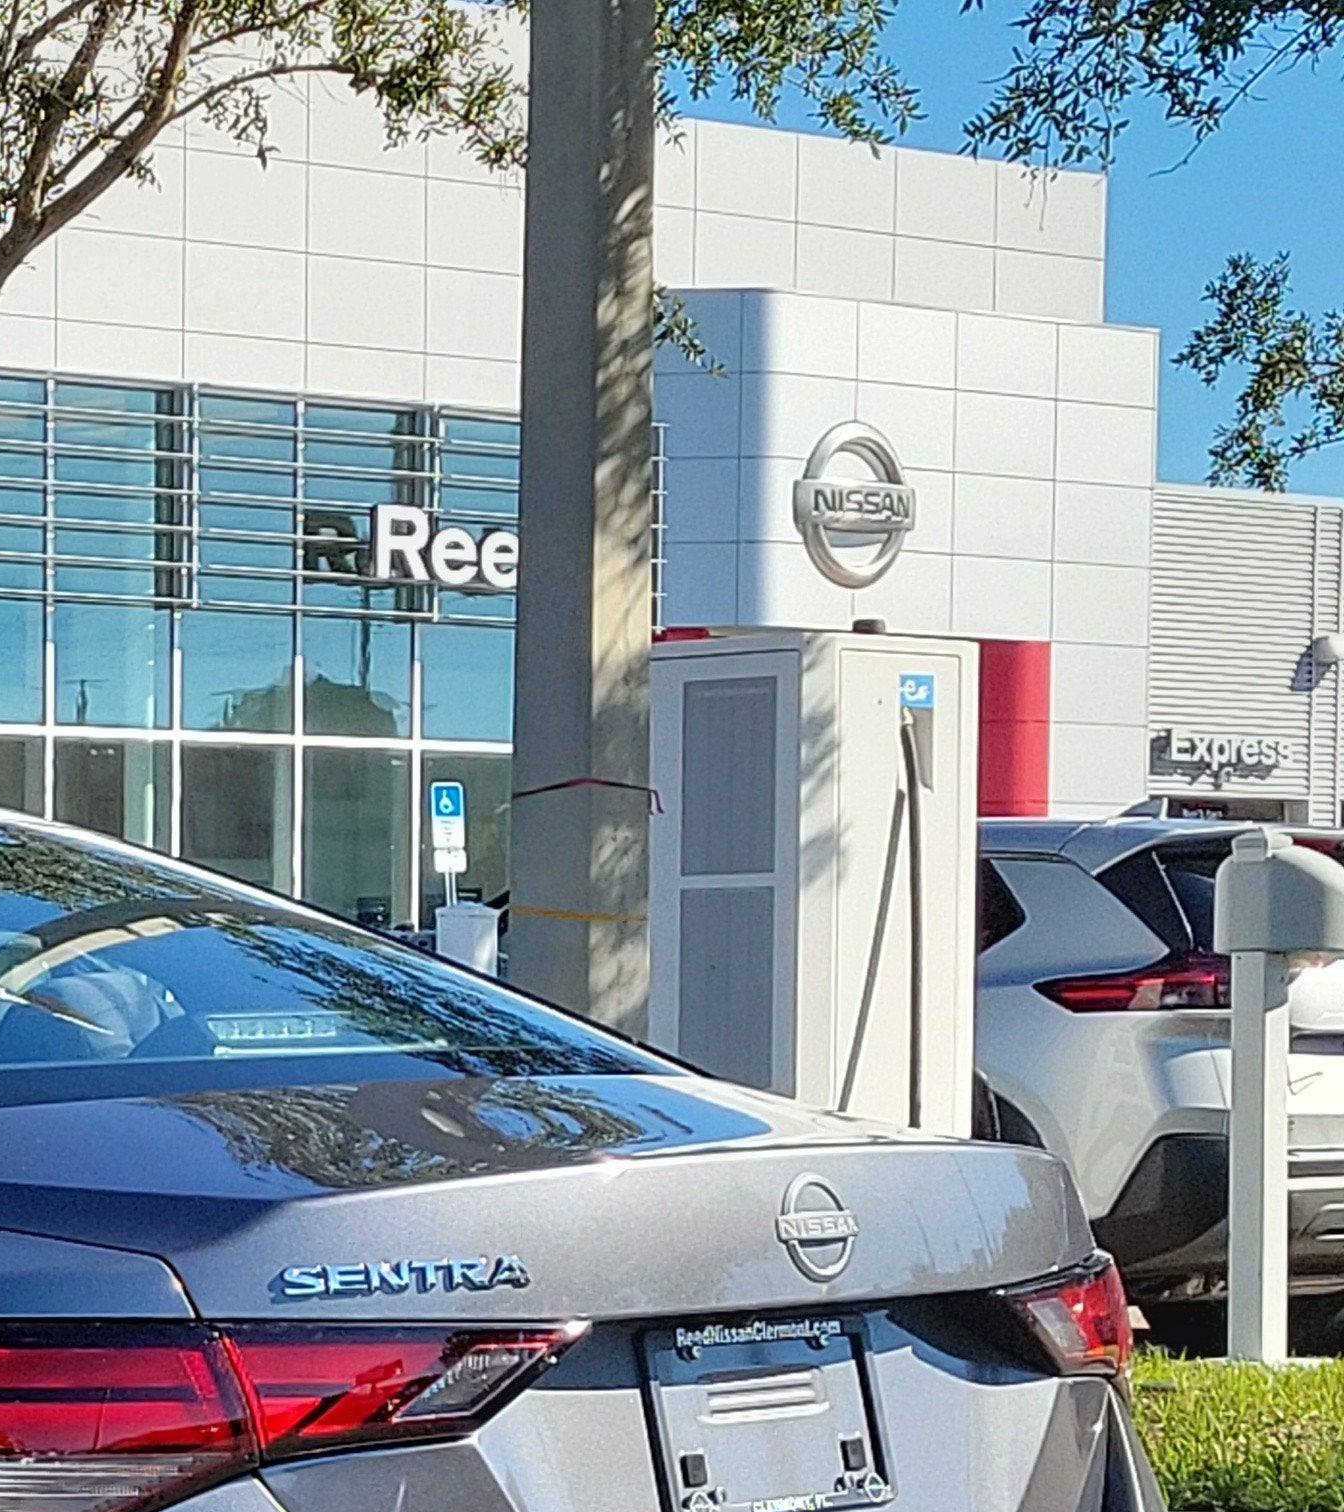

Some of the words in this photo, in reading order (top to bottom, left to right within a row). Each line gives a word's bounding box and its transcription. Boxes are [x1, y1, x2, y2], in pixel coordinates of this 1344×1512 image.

[812, 488, 911, 519] NISSAN
[376, 503, 519, 589] Ree
[1170, 729, 1295, 771] Express
[779, 1216, 860, 1239] NISSAN
[278, 1254, 532, 1297] SENTRA
